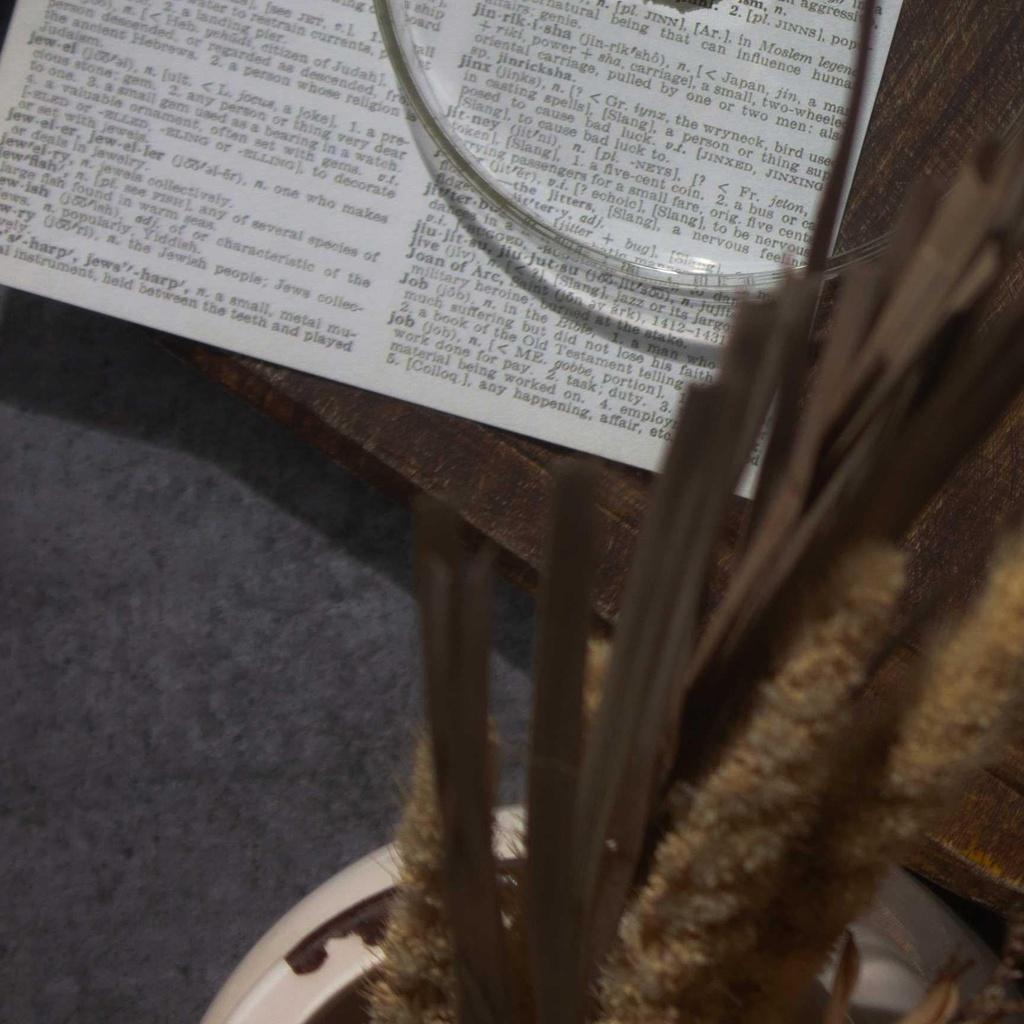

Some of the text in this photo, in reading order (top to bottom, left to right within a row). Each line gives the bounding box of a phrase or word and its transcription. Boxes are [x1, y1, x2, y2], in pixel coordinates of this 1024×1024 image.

[475, 34, 530, 56] oriental
[607, 70, 652, 89] pulled
[660, 81, 679, 97] by
[686, 91, 712, 106] one
[718, 100, 735, 112] or
[742, 104, 768, 121] two
[610, 13, 649, 35] being
[660, 27, 690, 45] that
[700, 40, 726, 55] can
[736, 48, 801, 75] influence
[404, 291, 442, 309] much
[450, 304, 514, 329] suffering
[522, 320, 546, 337] but
[553, 330, 577, 345] did
[584, 340, 609, 354] not
[616, 346, 644, 363] lose
[650, 355, 672, 372] his
[390, 342, 450, 365] material
[458, 358, 497, 380] being
[504, 373, 556, 395] worked
